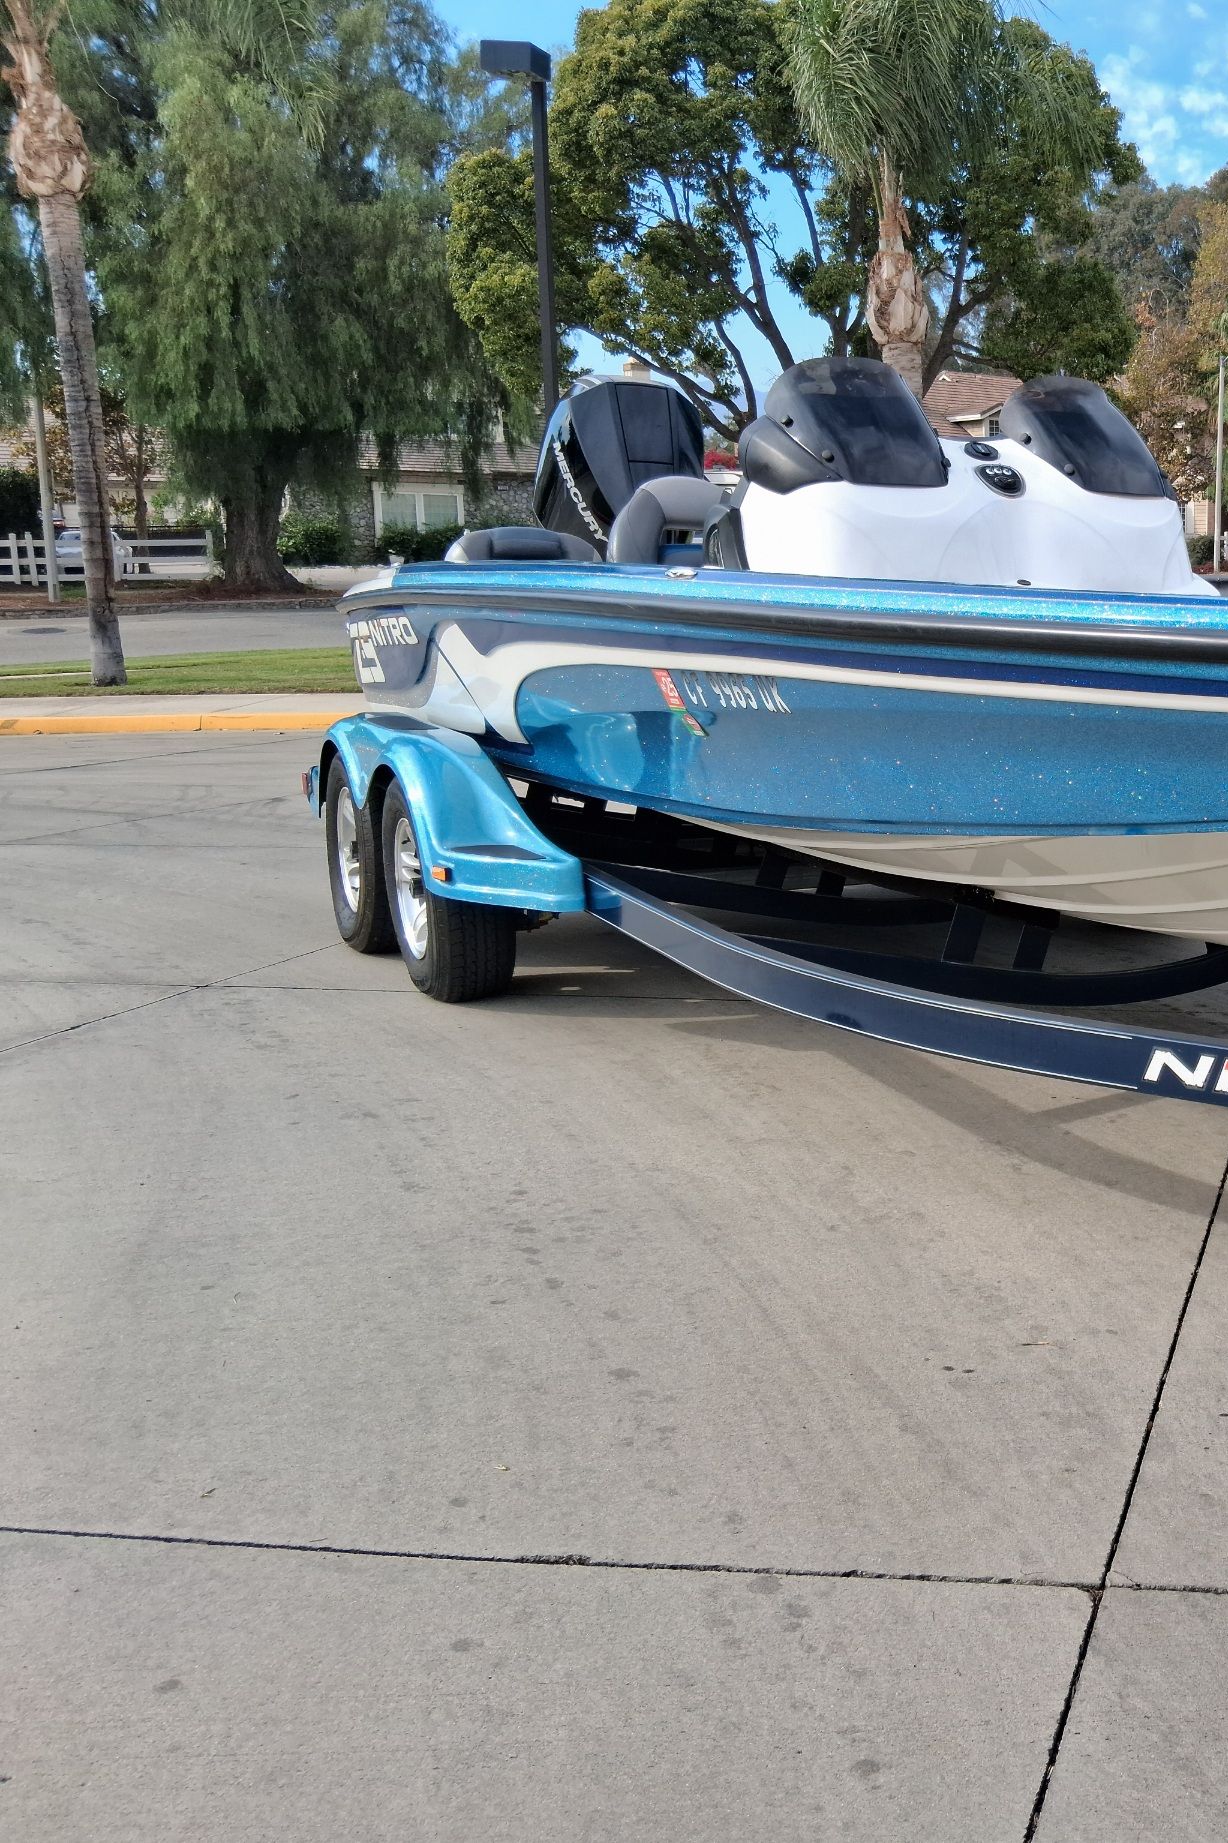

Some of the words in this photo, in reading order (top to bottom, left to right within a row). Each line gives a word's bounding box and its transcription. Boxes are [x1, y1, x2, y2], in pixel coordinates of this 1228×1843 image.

[553, 441, 609, 543] MERCURY
[681, 673, 708, 708] CF
[706, 674, 758, 710] 9965
